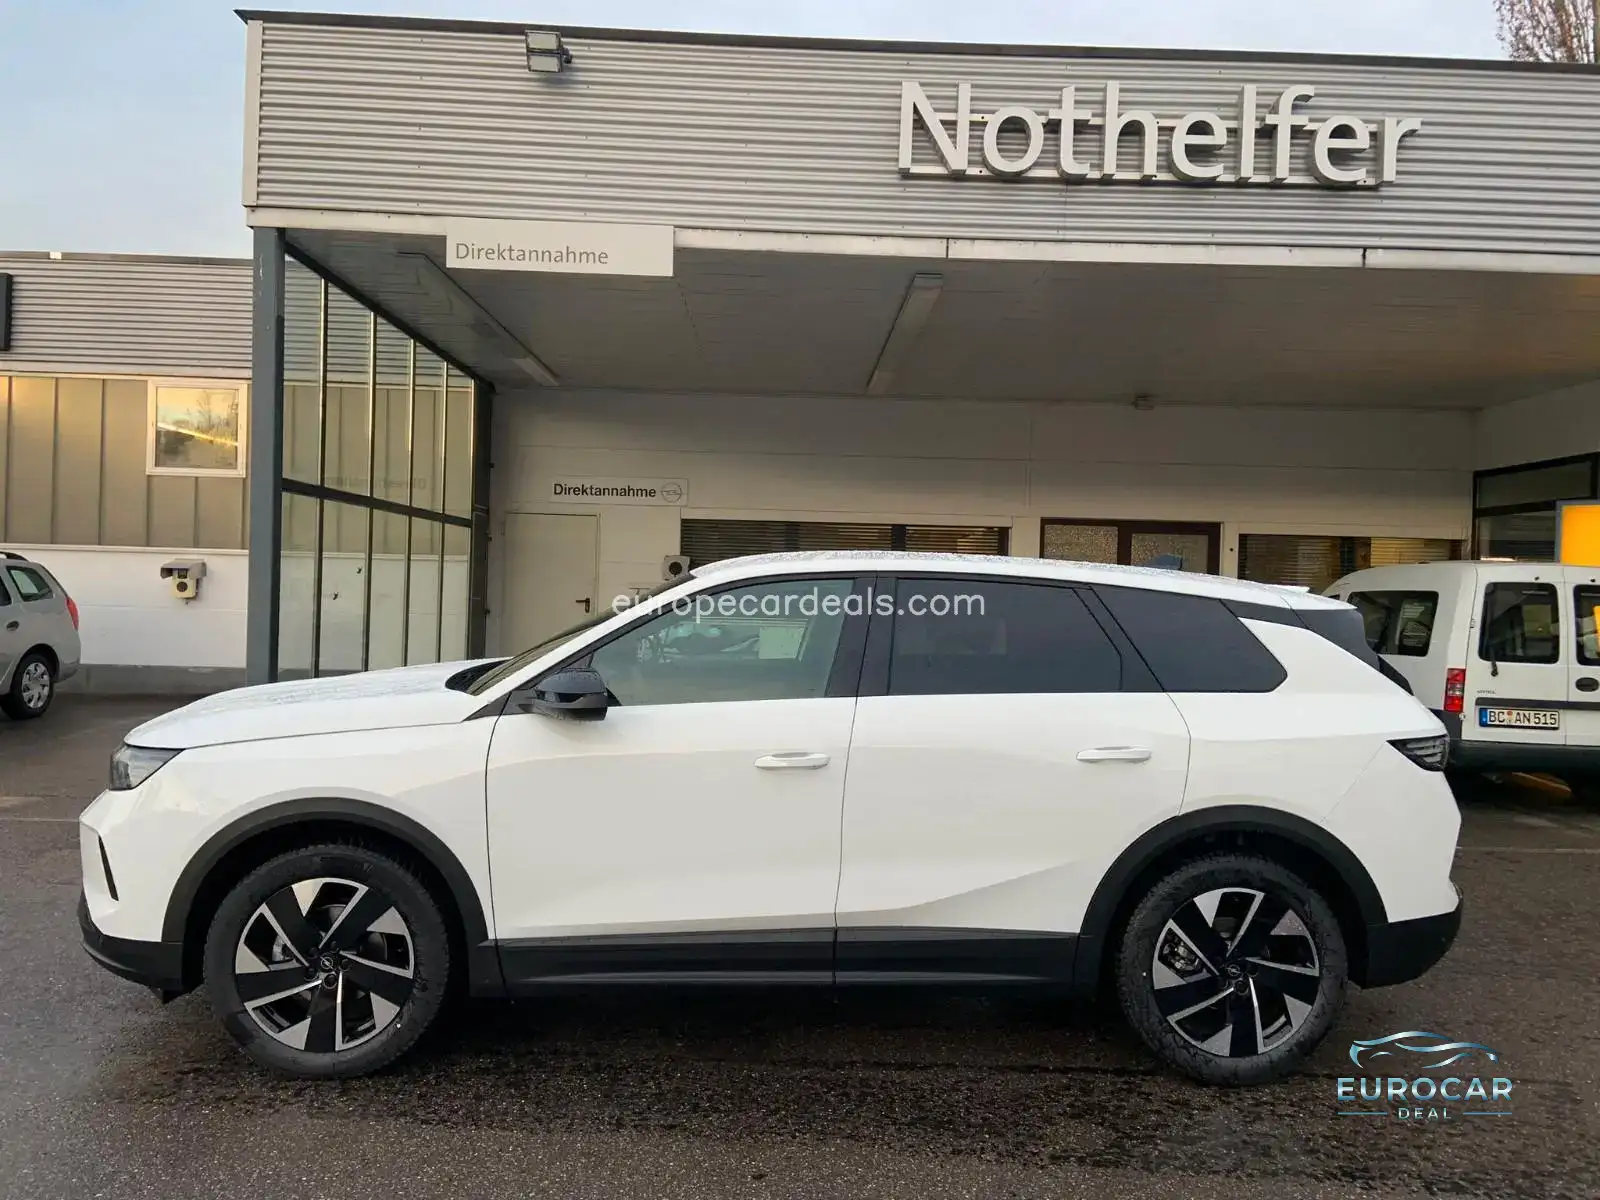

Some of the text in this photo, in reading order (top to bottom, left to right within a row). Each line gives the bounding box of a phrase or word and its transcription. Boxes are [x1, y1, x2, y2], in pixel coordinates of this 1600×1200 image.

[899, 80, 1422, 186] Nothelfer
[455, 242, 609, 265] Direktannahme
[553, 483, 657, 498] Direktannahme
[1488, 710, 1557, 726] BC AN 515
